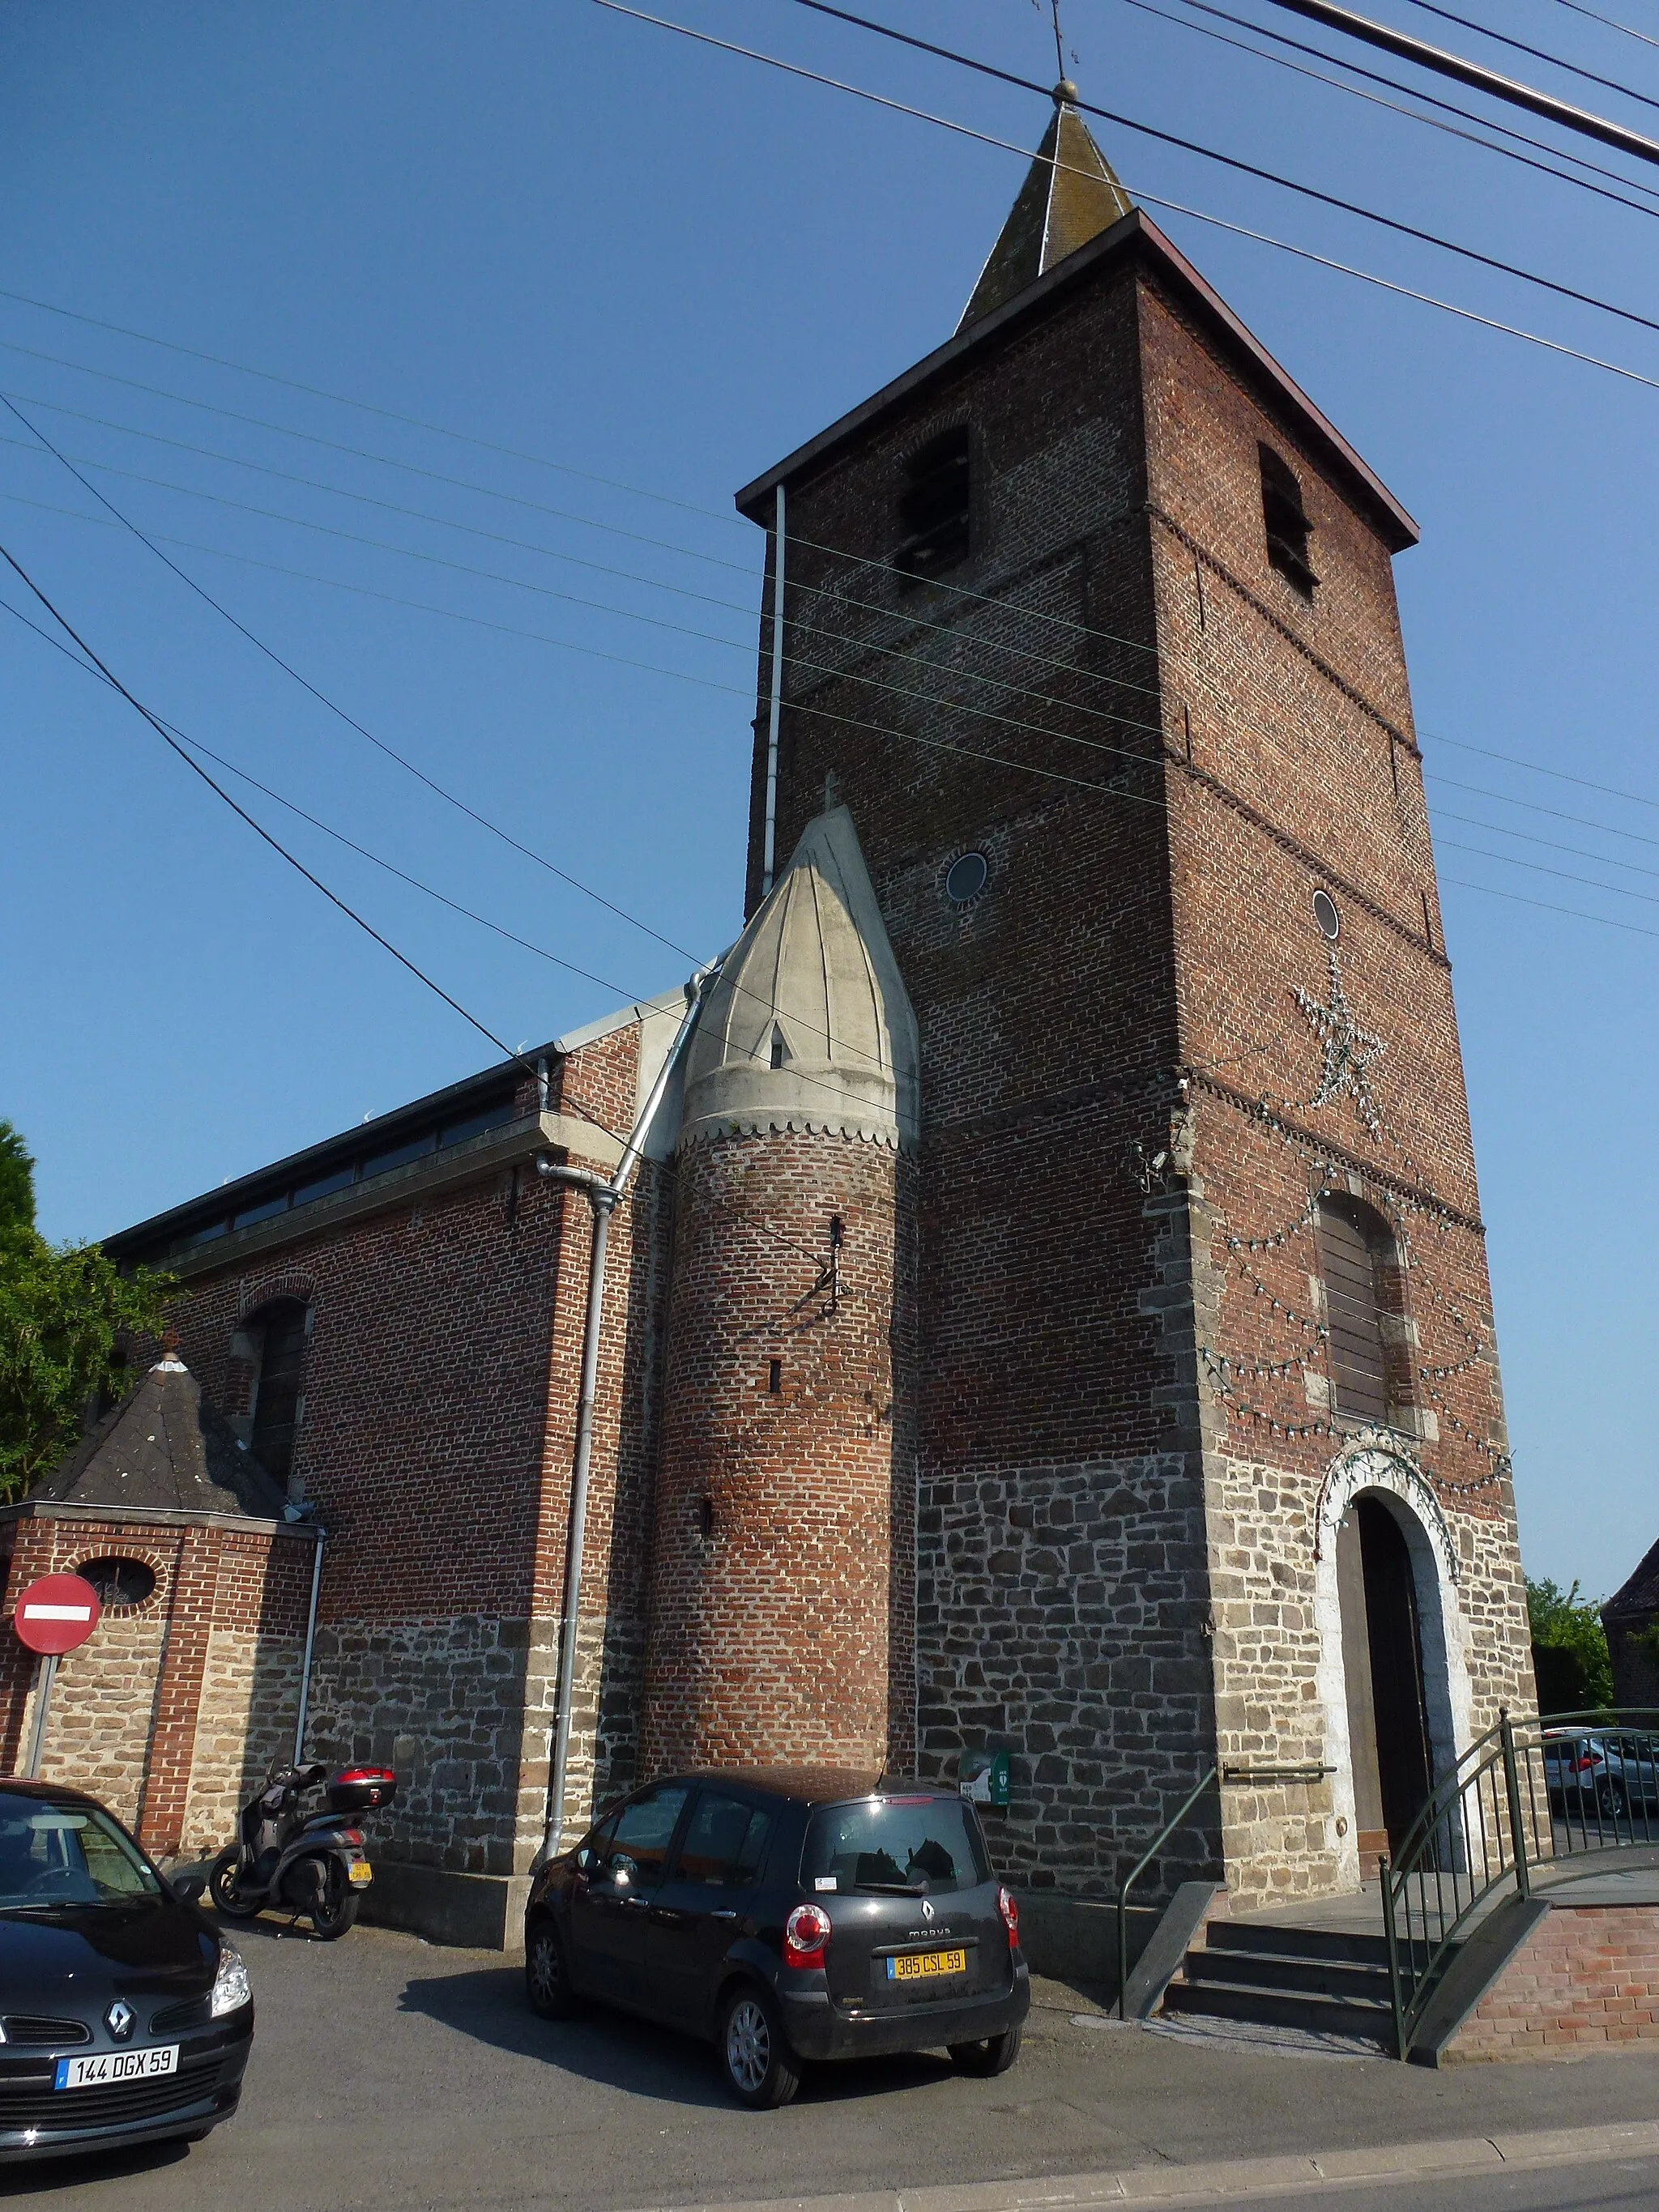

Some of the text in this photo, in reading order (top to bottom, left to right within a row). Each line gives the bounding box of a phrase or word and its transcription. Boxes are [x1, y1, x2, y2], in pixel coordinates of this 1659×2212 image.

[898, 1952, 961, 1975] 385 CSL 59
[77, 2050, 172, 2082] 144 DGX 59
